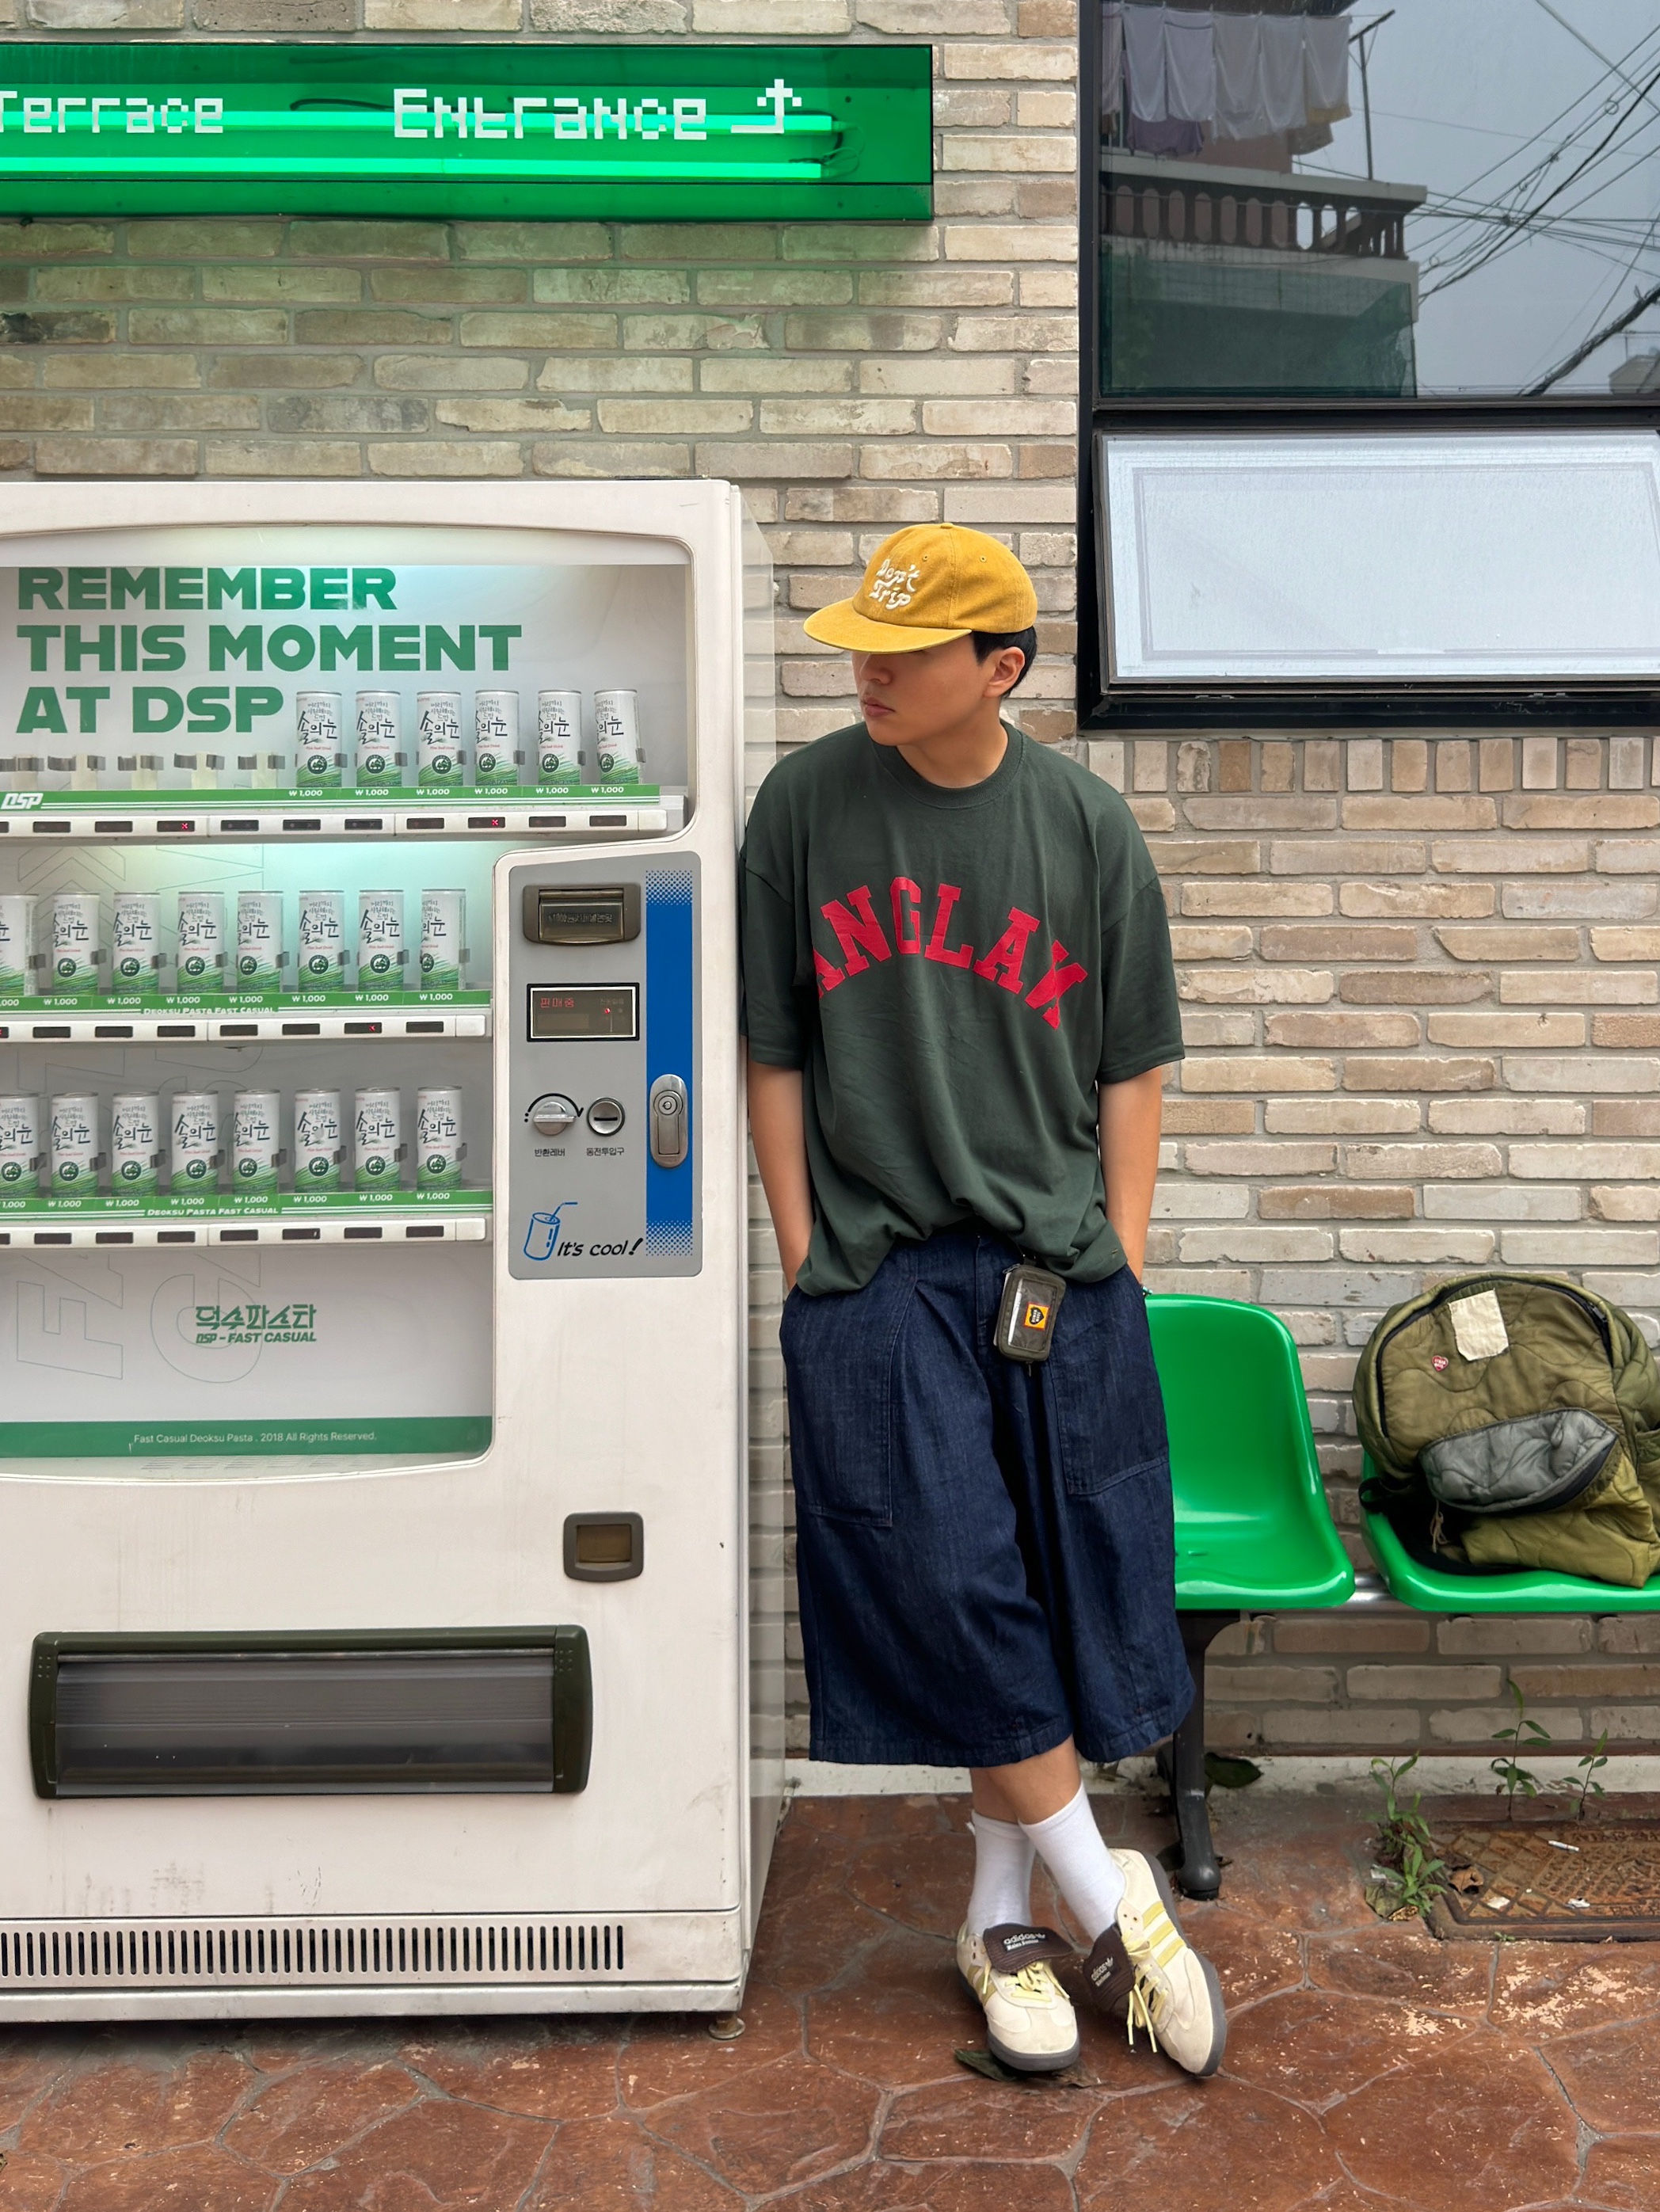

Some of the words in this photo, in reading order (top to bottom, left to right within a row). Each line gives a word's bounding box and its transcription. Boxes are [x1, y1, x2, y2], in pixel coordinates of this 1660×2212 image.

[394, 89, 707, 140] Entrance
[876, 558, 920, 592] Don't
[17, 567, 397, 611] REMEMBER
[869, 578, 912, 610] Trip
[16, 625, 185, 672] THIS
[210, 623, 522, 672] MOMENT
[16, 686, 110, 733] AT
[133, 685, 284, 733] DSP
[298, 710, 337, 745] 솔의눈
[358, 710, 396, 744] 솔의눈
[420, 710, 459, 745] 솔의눈
[0, 793, 44, 809] DSP
[112, 912, 152, 947] 솔의눈
[177, 911, 217, 946] 솔의눈
[299, 909, 339, 945] 솔의눈
[360, 909, 400, 944] 솔의눈
[421, 917, 447, 936] 의눈
[0, 999, 20, 1007] ,000
[177, 996, 200, 1005] 1,000
[240, 996, 263, 1004] 1,000
[303, 995, 326, 1003] 1,000
[429, 993, 453, 1002] 1,000
[112, 1115, 153, 1150] 솔의눈
[174, 1114, 216, 1149] 솔의눈
[356, 1110, 395, 1146] 솔의눈
[417, 1109, 457, 1144] 솔의눈
[535, 1148, 565, 1157] 반환레버
[586, 1147, 625, 1157] 동전투입구
[58, 1200, 82, 1209] 1,000
[116, 1199, 139, 1208] 1,000
[181, 1197, 205, 1206] 1,000
[303, 1195, 327, 1204] 1,000
[369, 1194, 393, 1202] 1,000
[558, 1241, 584, 1257] It's
[196, 1304, 317, 1331] 덕수파스타
[227, 1332, 262, 1343] FAST
[264, 1331, 317, 1343] CASUAL
[134, 1434, 154, 1443] Fast
[156, 1433, 188, 1443] Casual
[189, 1433, 225, 1443] Deoksu
[227, 1433, 253, 1442] Pasta
[260, 1433, 284, 1442] 2018
[285, 1432, 298, 1441] All
[299, 1432, 329, 1443] Rights
[330, 1431, 377, 1441] Reserved.
